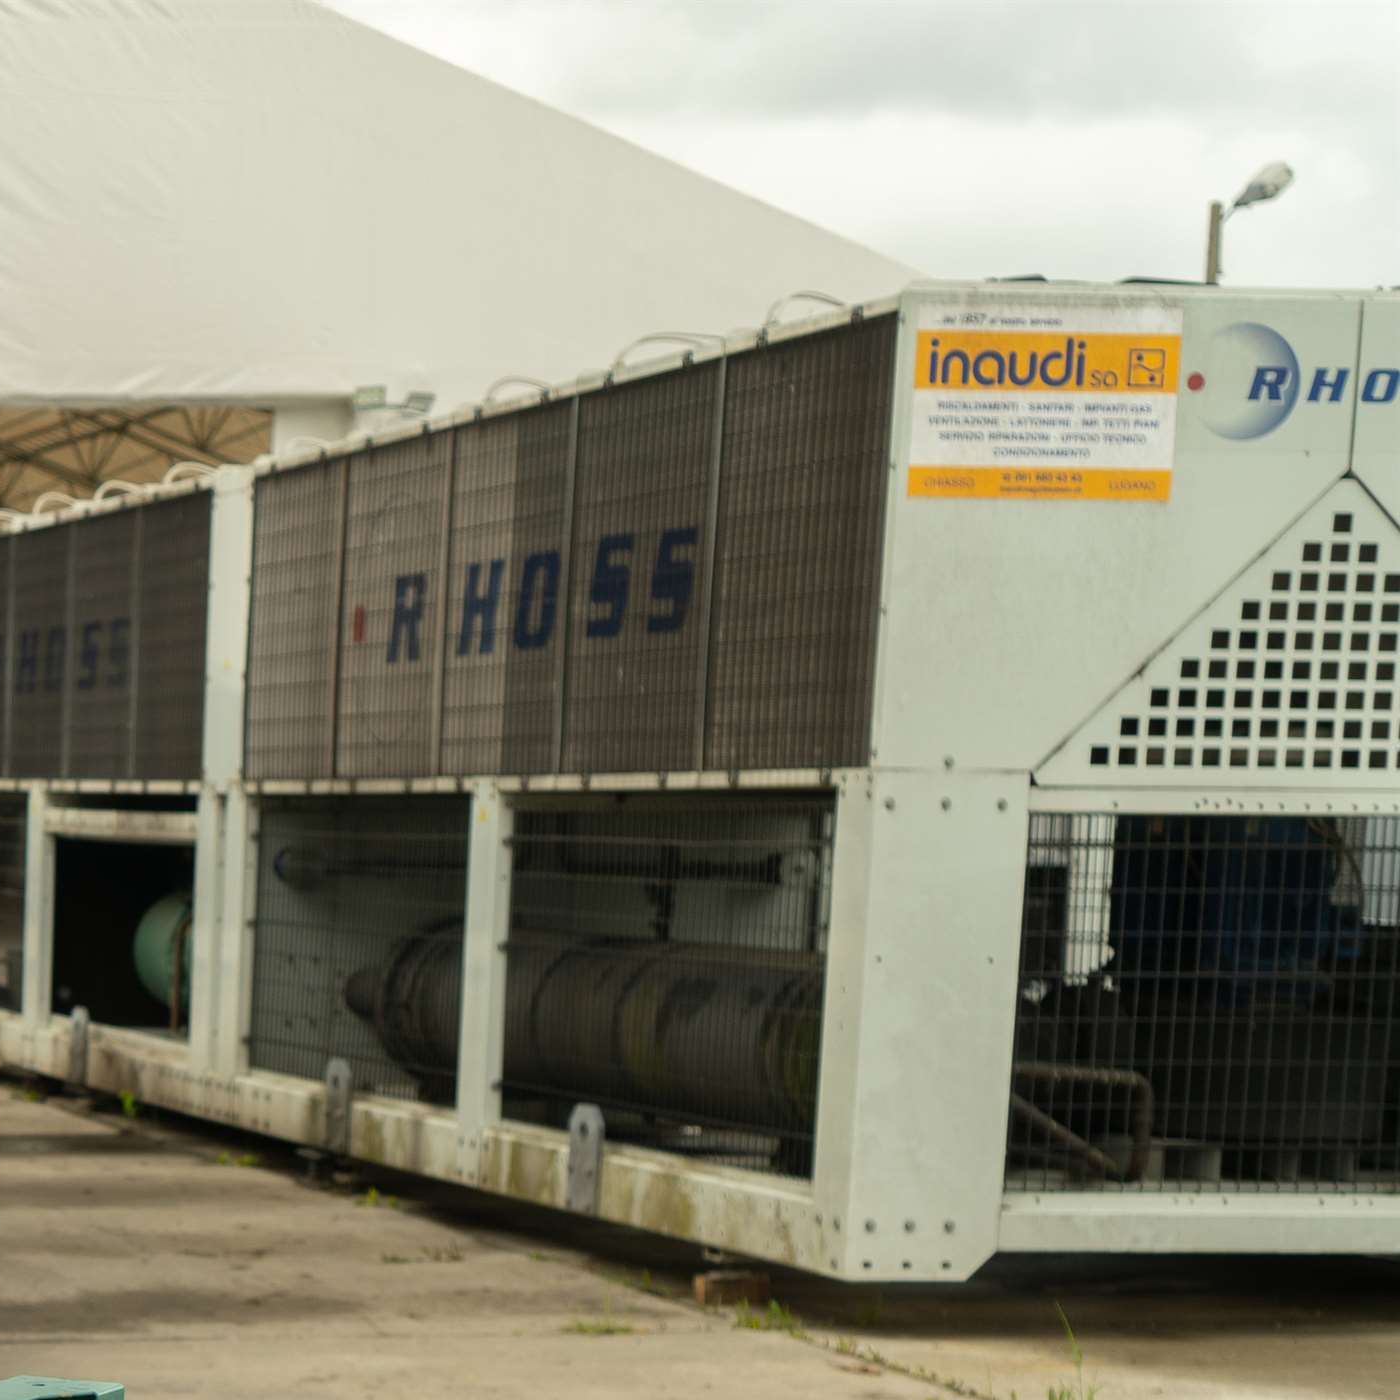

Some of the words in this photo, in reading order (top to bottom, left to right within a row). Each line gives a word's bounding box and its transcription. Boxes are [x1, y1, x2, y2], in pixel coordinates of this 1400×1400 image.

[929, 337, 1087, 386] inaudi
[1090, 370, 1119, 388] sa
[386, 527, 698, 664] RHOSS
